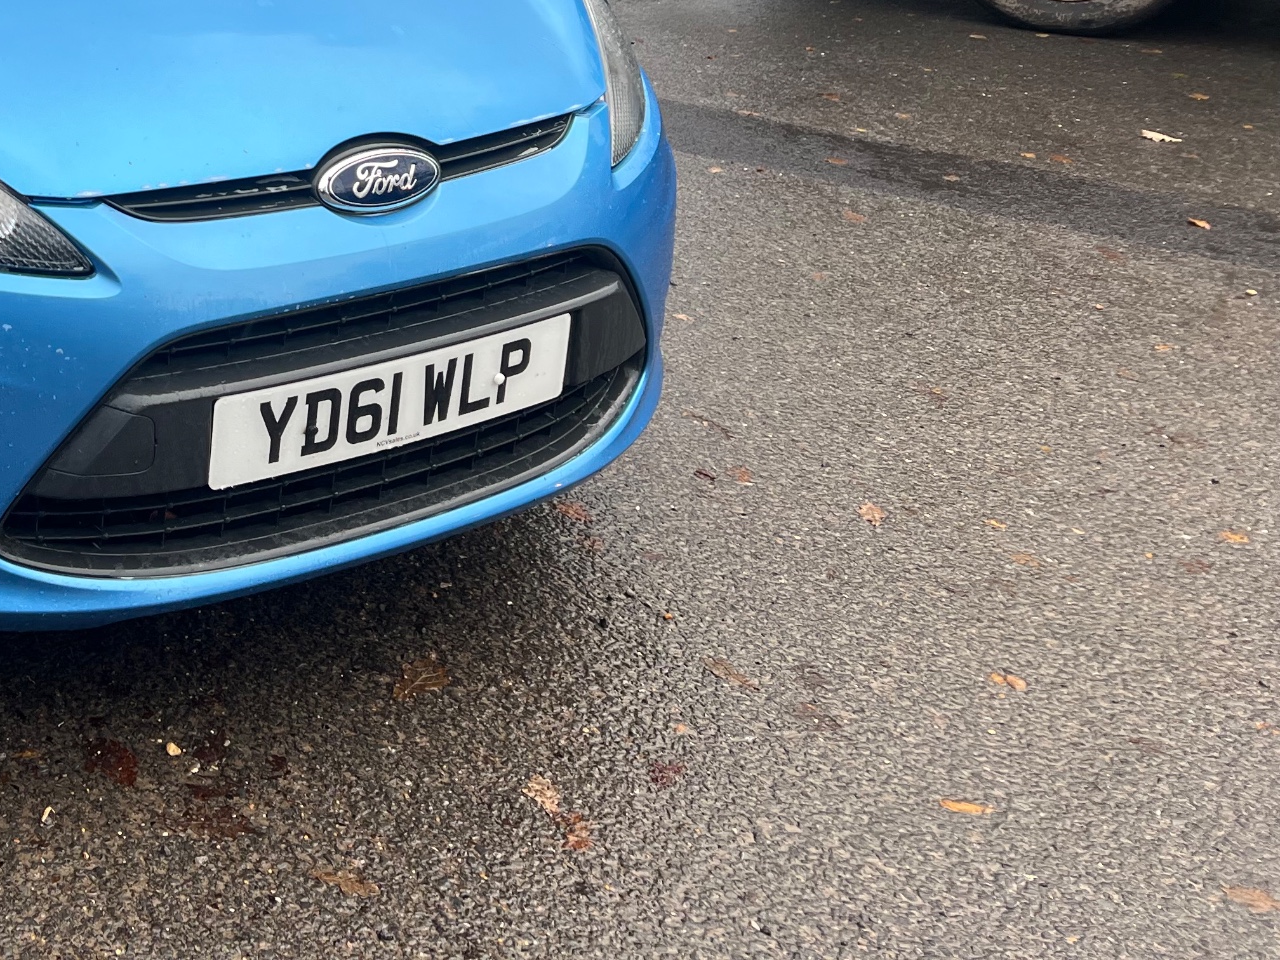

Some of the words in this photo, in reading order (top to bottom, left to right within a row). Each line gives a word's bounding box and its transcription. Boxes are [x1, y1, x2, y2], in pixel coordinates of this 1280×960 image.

[352, 159, 418, 199] Ford
[259, 371, 403, 464] YD61
[423, 338, 532, 426] WLP
